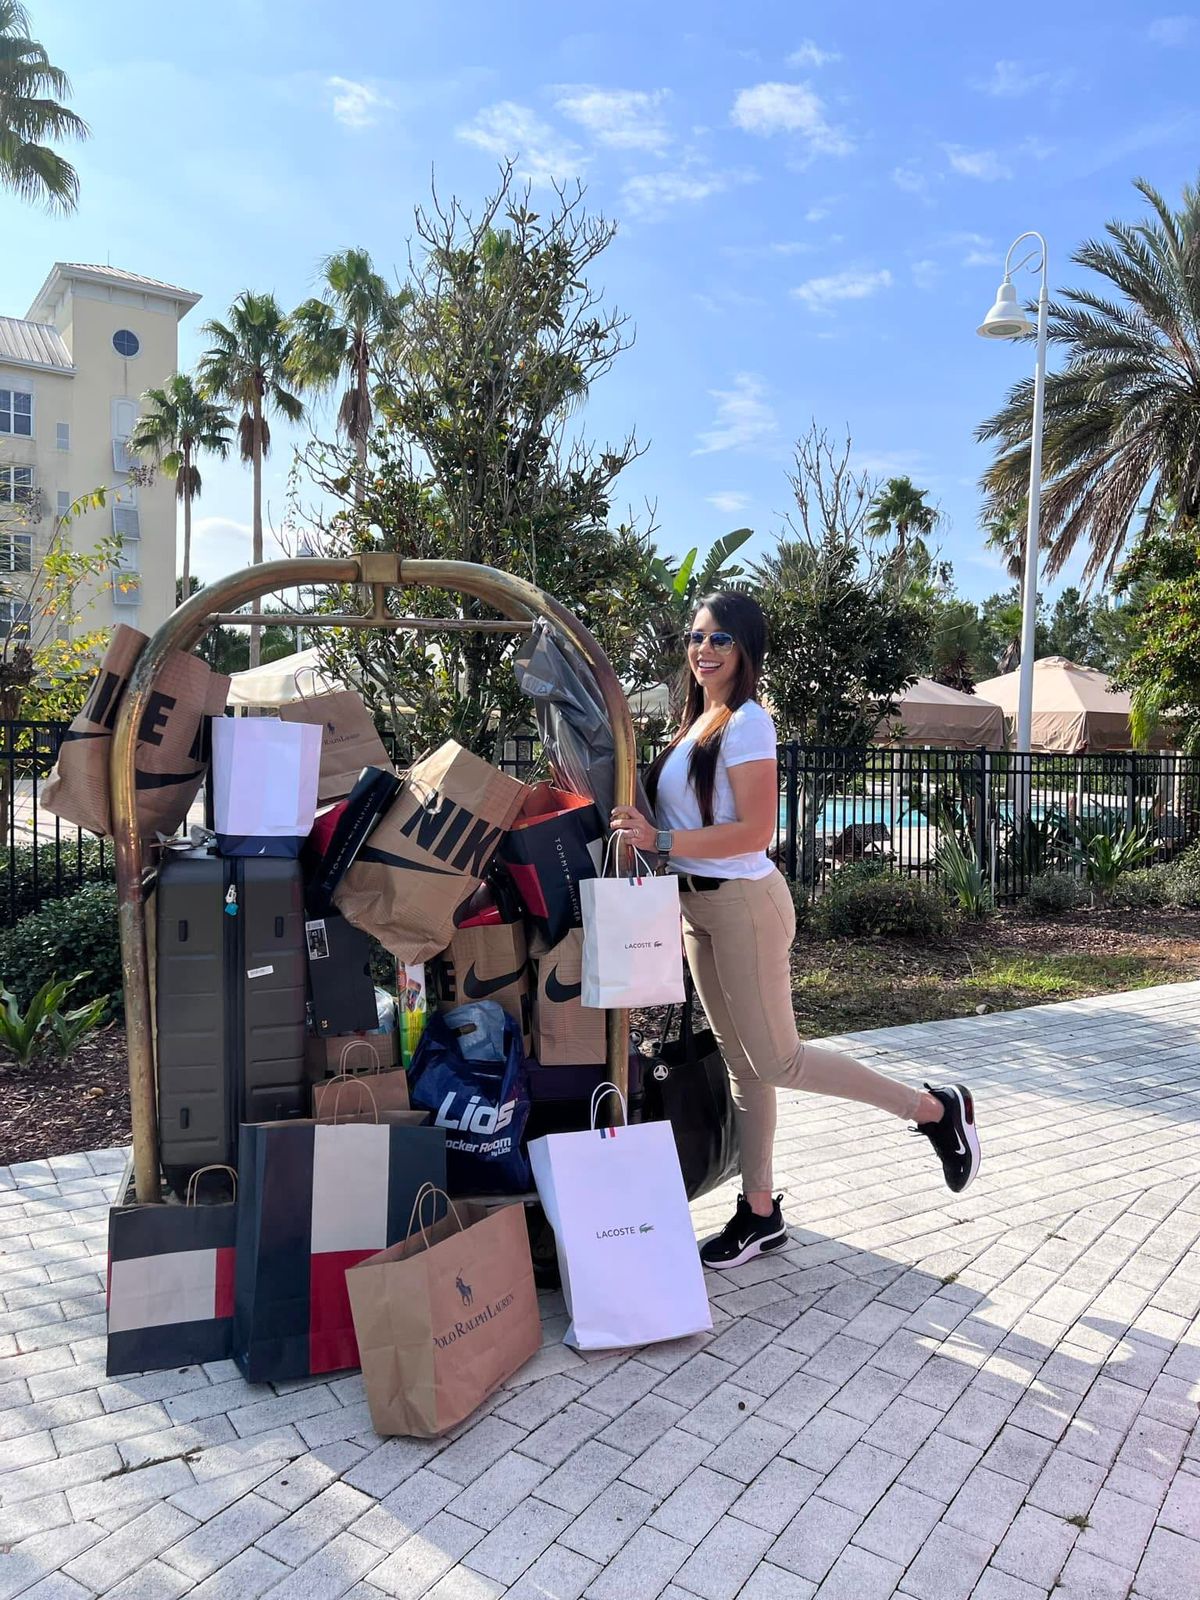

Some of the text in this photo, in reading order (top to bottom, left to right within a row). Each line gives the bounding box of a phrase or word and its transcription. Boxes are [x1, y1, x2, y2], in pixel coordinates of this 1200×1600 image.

[400, 792, 508, 880] NIK
[329, 841, 349, 875] TOMMY
[555, 838, 570, 874] TOMMY
[624, 942, 651, 950] LACOSTE
[434, 1091, 515, 1135] Lids
[445, 1137, 512, 1153] ocker Room
[596, 1226, 636, 1239] LACOSTE
[454, 1311, 489, 1338] RALPH
[486, 1294, 515, 1319] LAUREN
